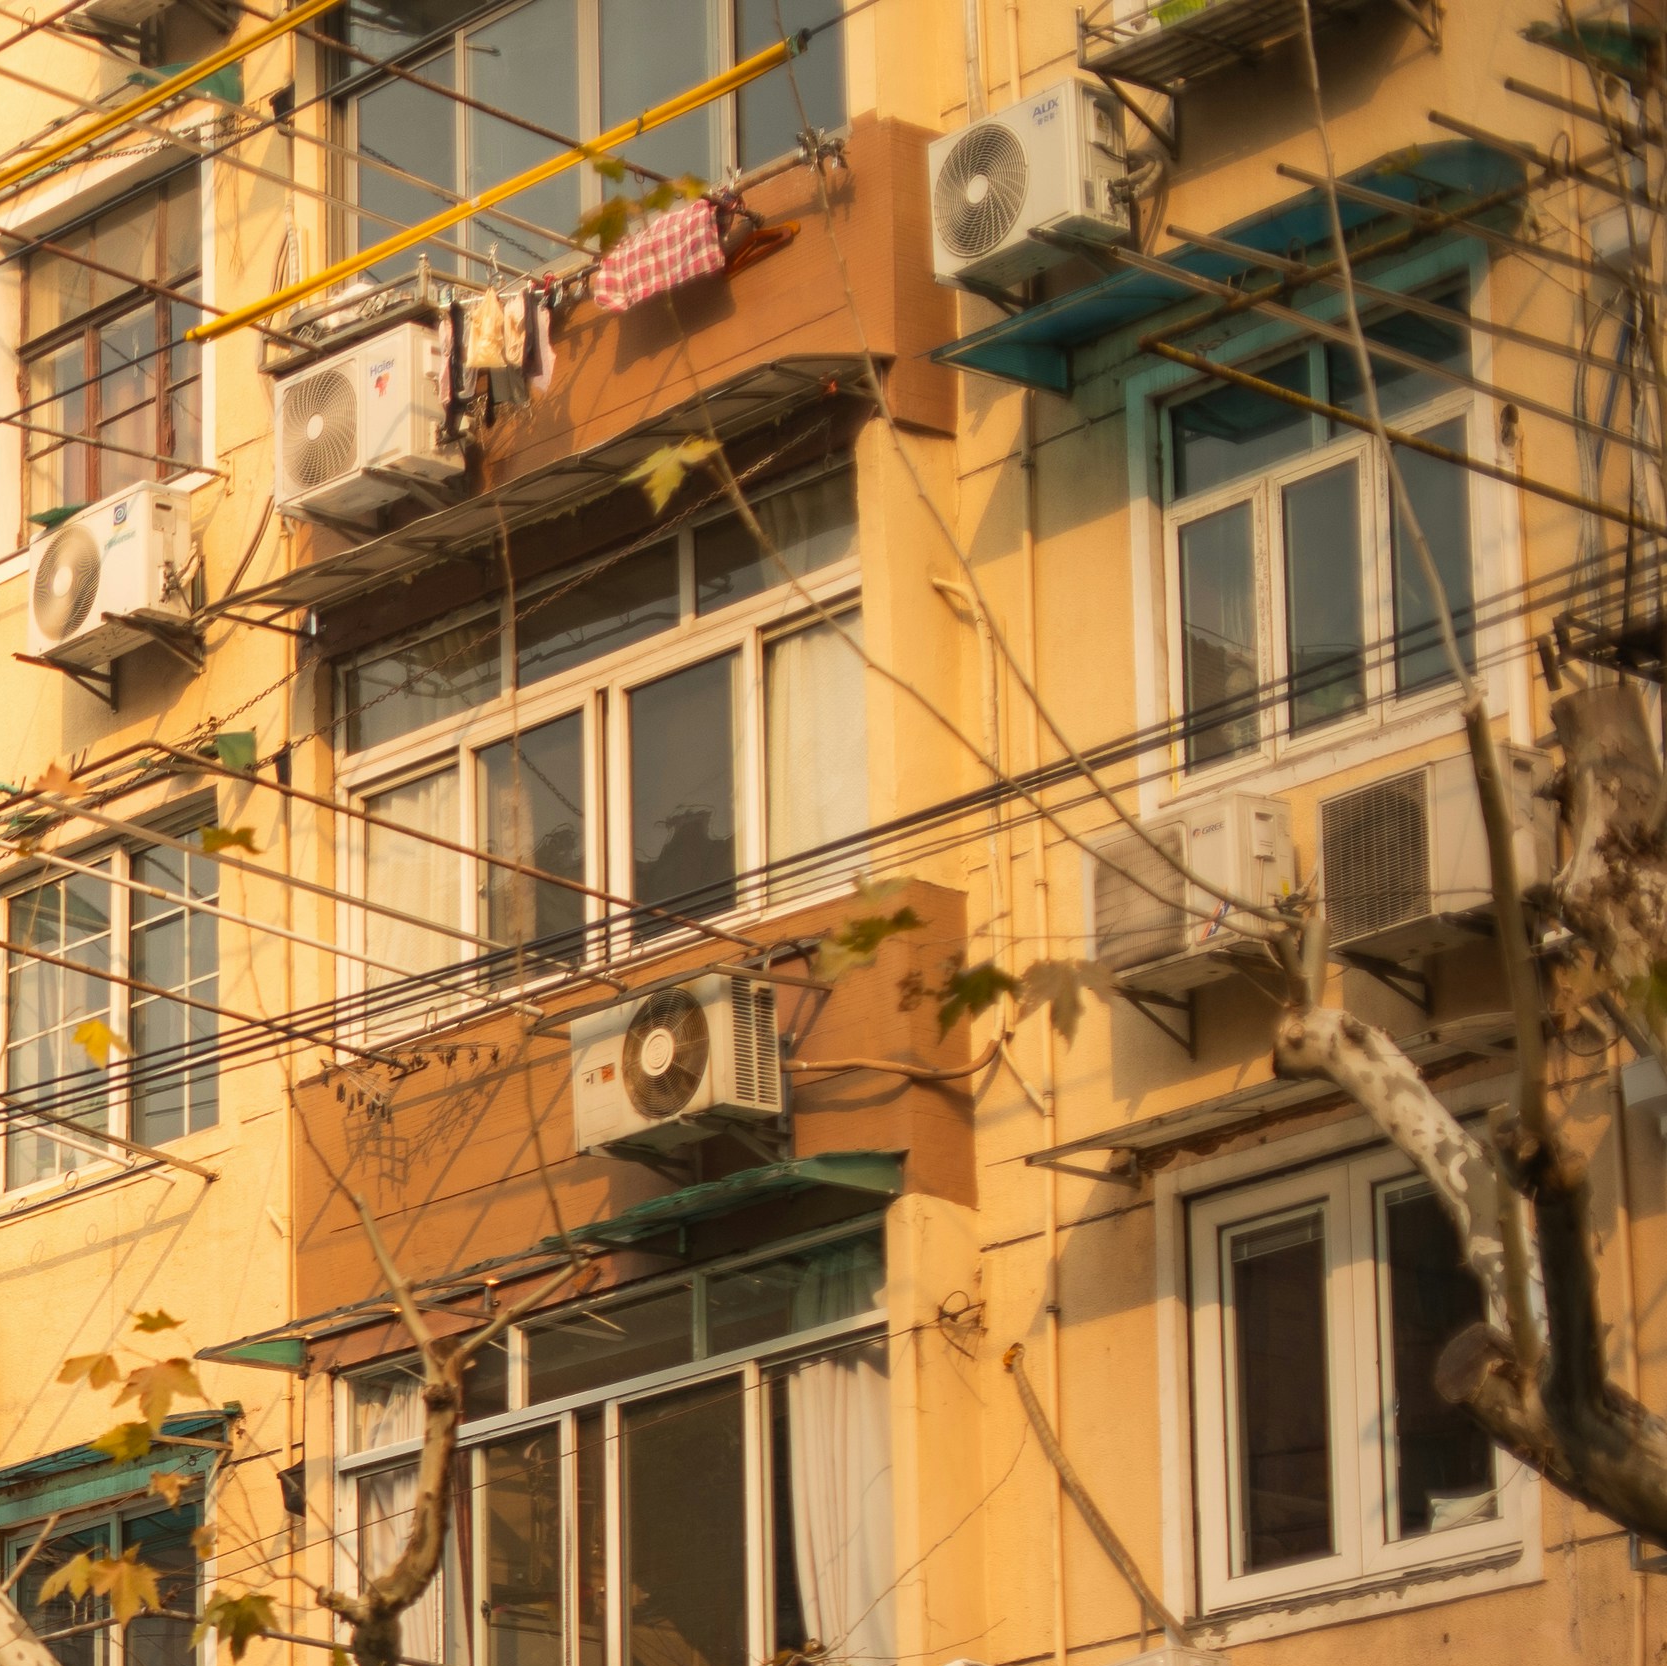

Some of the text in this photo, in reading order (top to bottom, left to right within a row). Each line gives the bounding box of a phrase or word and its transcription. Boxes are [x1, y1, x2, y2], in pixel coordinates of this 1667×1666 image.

[1032, 96, 1059, 118] AUX
[370, 358, 394, 377] Haier
[1201, 821, 1225, 834] GREE
